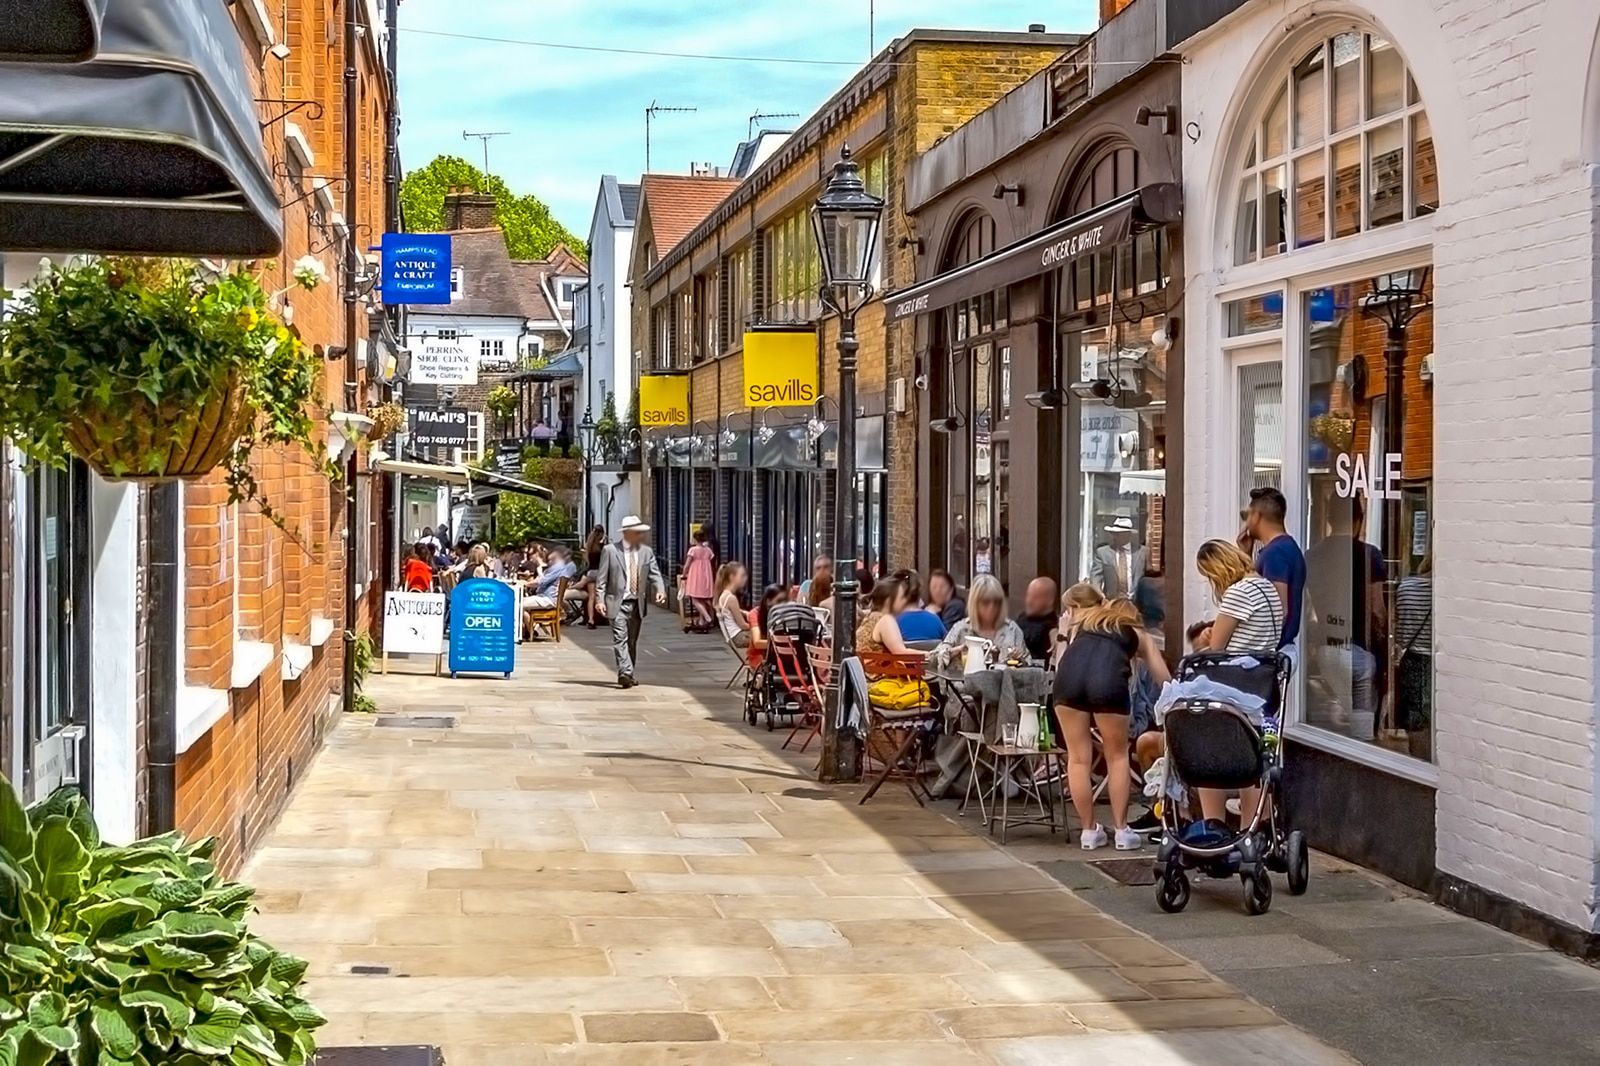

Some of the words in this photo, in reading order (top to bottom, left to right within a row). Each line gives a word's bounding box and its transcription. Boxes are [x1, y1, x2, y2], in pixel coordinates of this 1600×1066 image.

[395, 247, 438, 255] HAMPSTEAD
[1041, 239, 1070, 266] GINGER
[1070, 236, 1077, 256] &
[1078, 225, 1103, 252] WHITE
[395, 261, 437, 271] ANTIQUE
[394, 271, 400, 279] &
[403, 271, 434, 279] CRAFT
[396, 282, 435, 290] EMPORIUM
[426, 346, 464, 354] PERRINS
[417, 355, 438, 363] SHOE
[749, 379, 813, 402] savills
[418, 410, 466, 424] MANI'S
[642, 408, 686, 422] savills
[1335, 452, 1402, 499] SALE
[387, 597, 443, 616] ANTIQUES
[465, 616, 502, 628] OPEN
